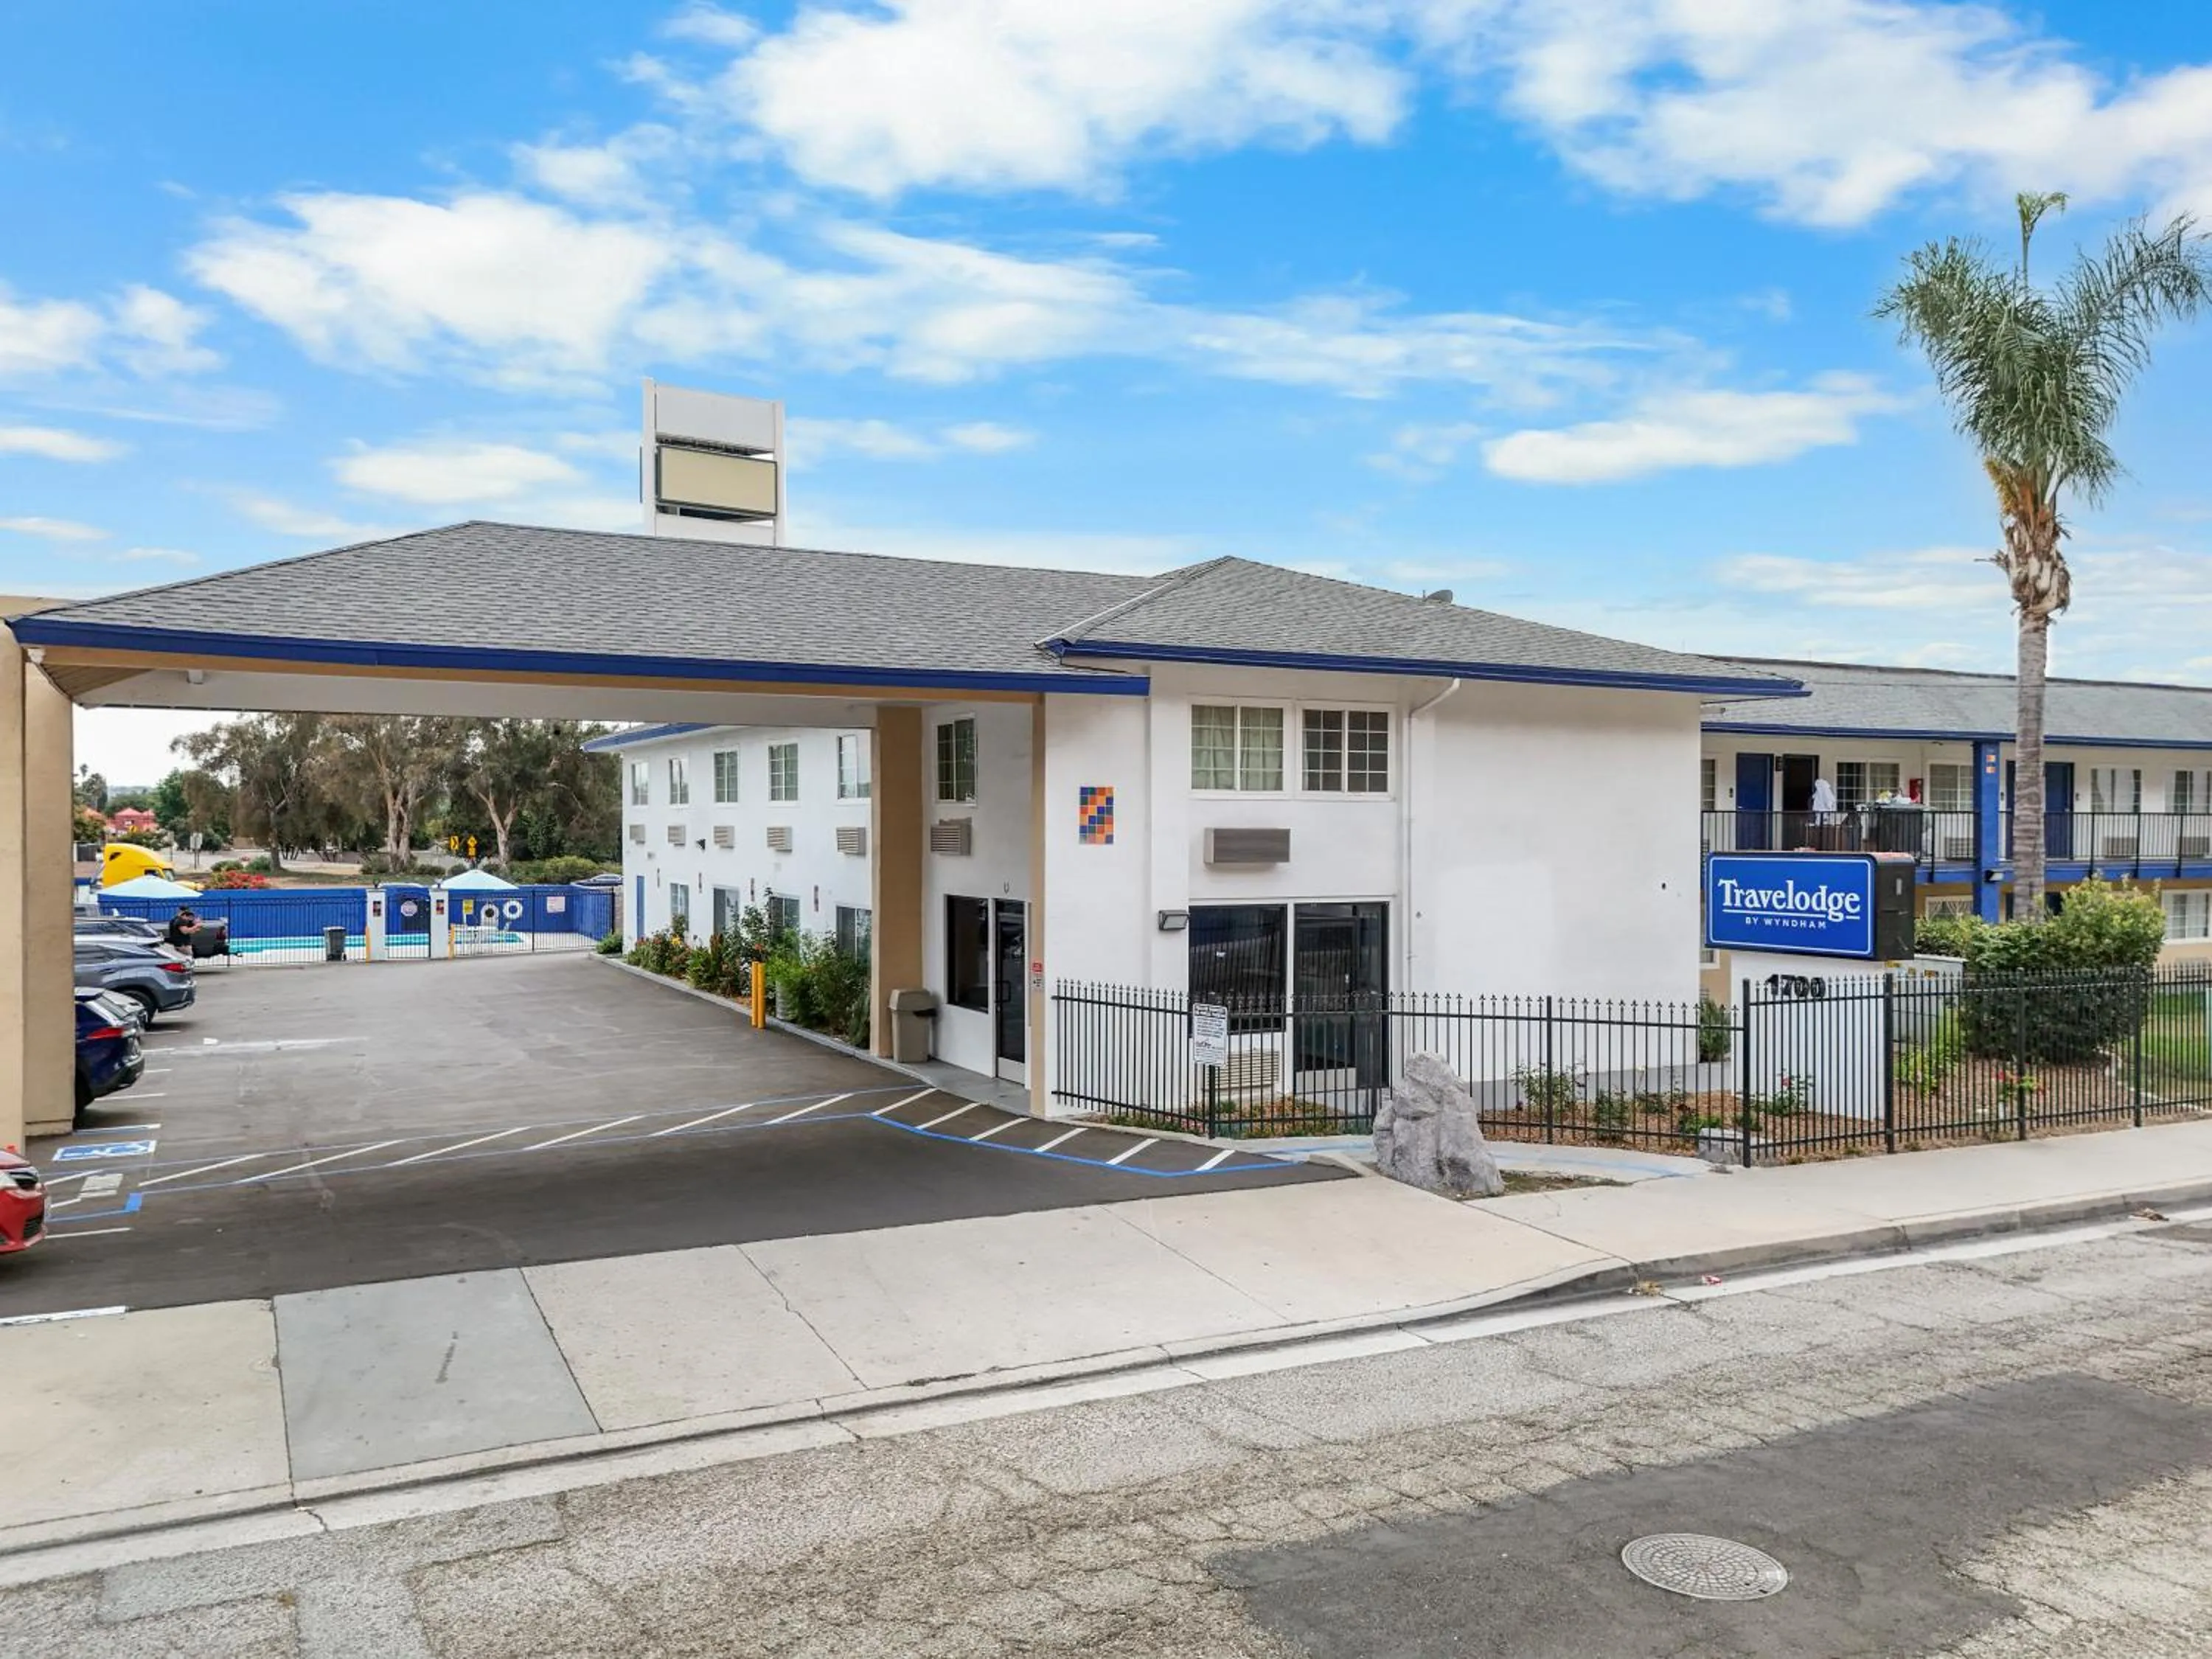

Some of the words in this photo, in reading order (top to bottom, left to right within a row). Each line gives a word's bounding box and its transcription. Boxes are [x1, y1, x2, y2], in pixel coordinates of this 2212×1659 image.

[1717, 879, 1861, 922] Travelodge
[1745, 917, 1760, 925] BY
[1764, 918, 1826, 929] WYNDHAM
[1765, 974, 1826, 998] 1700
